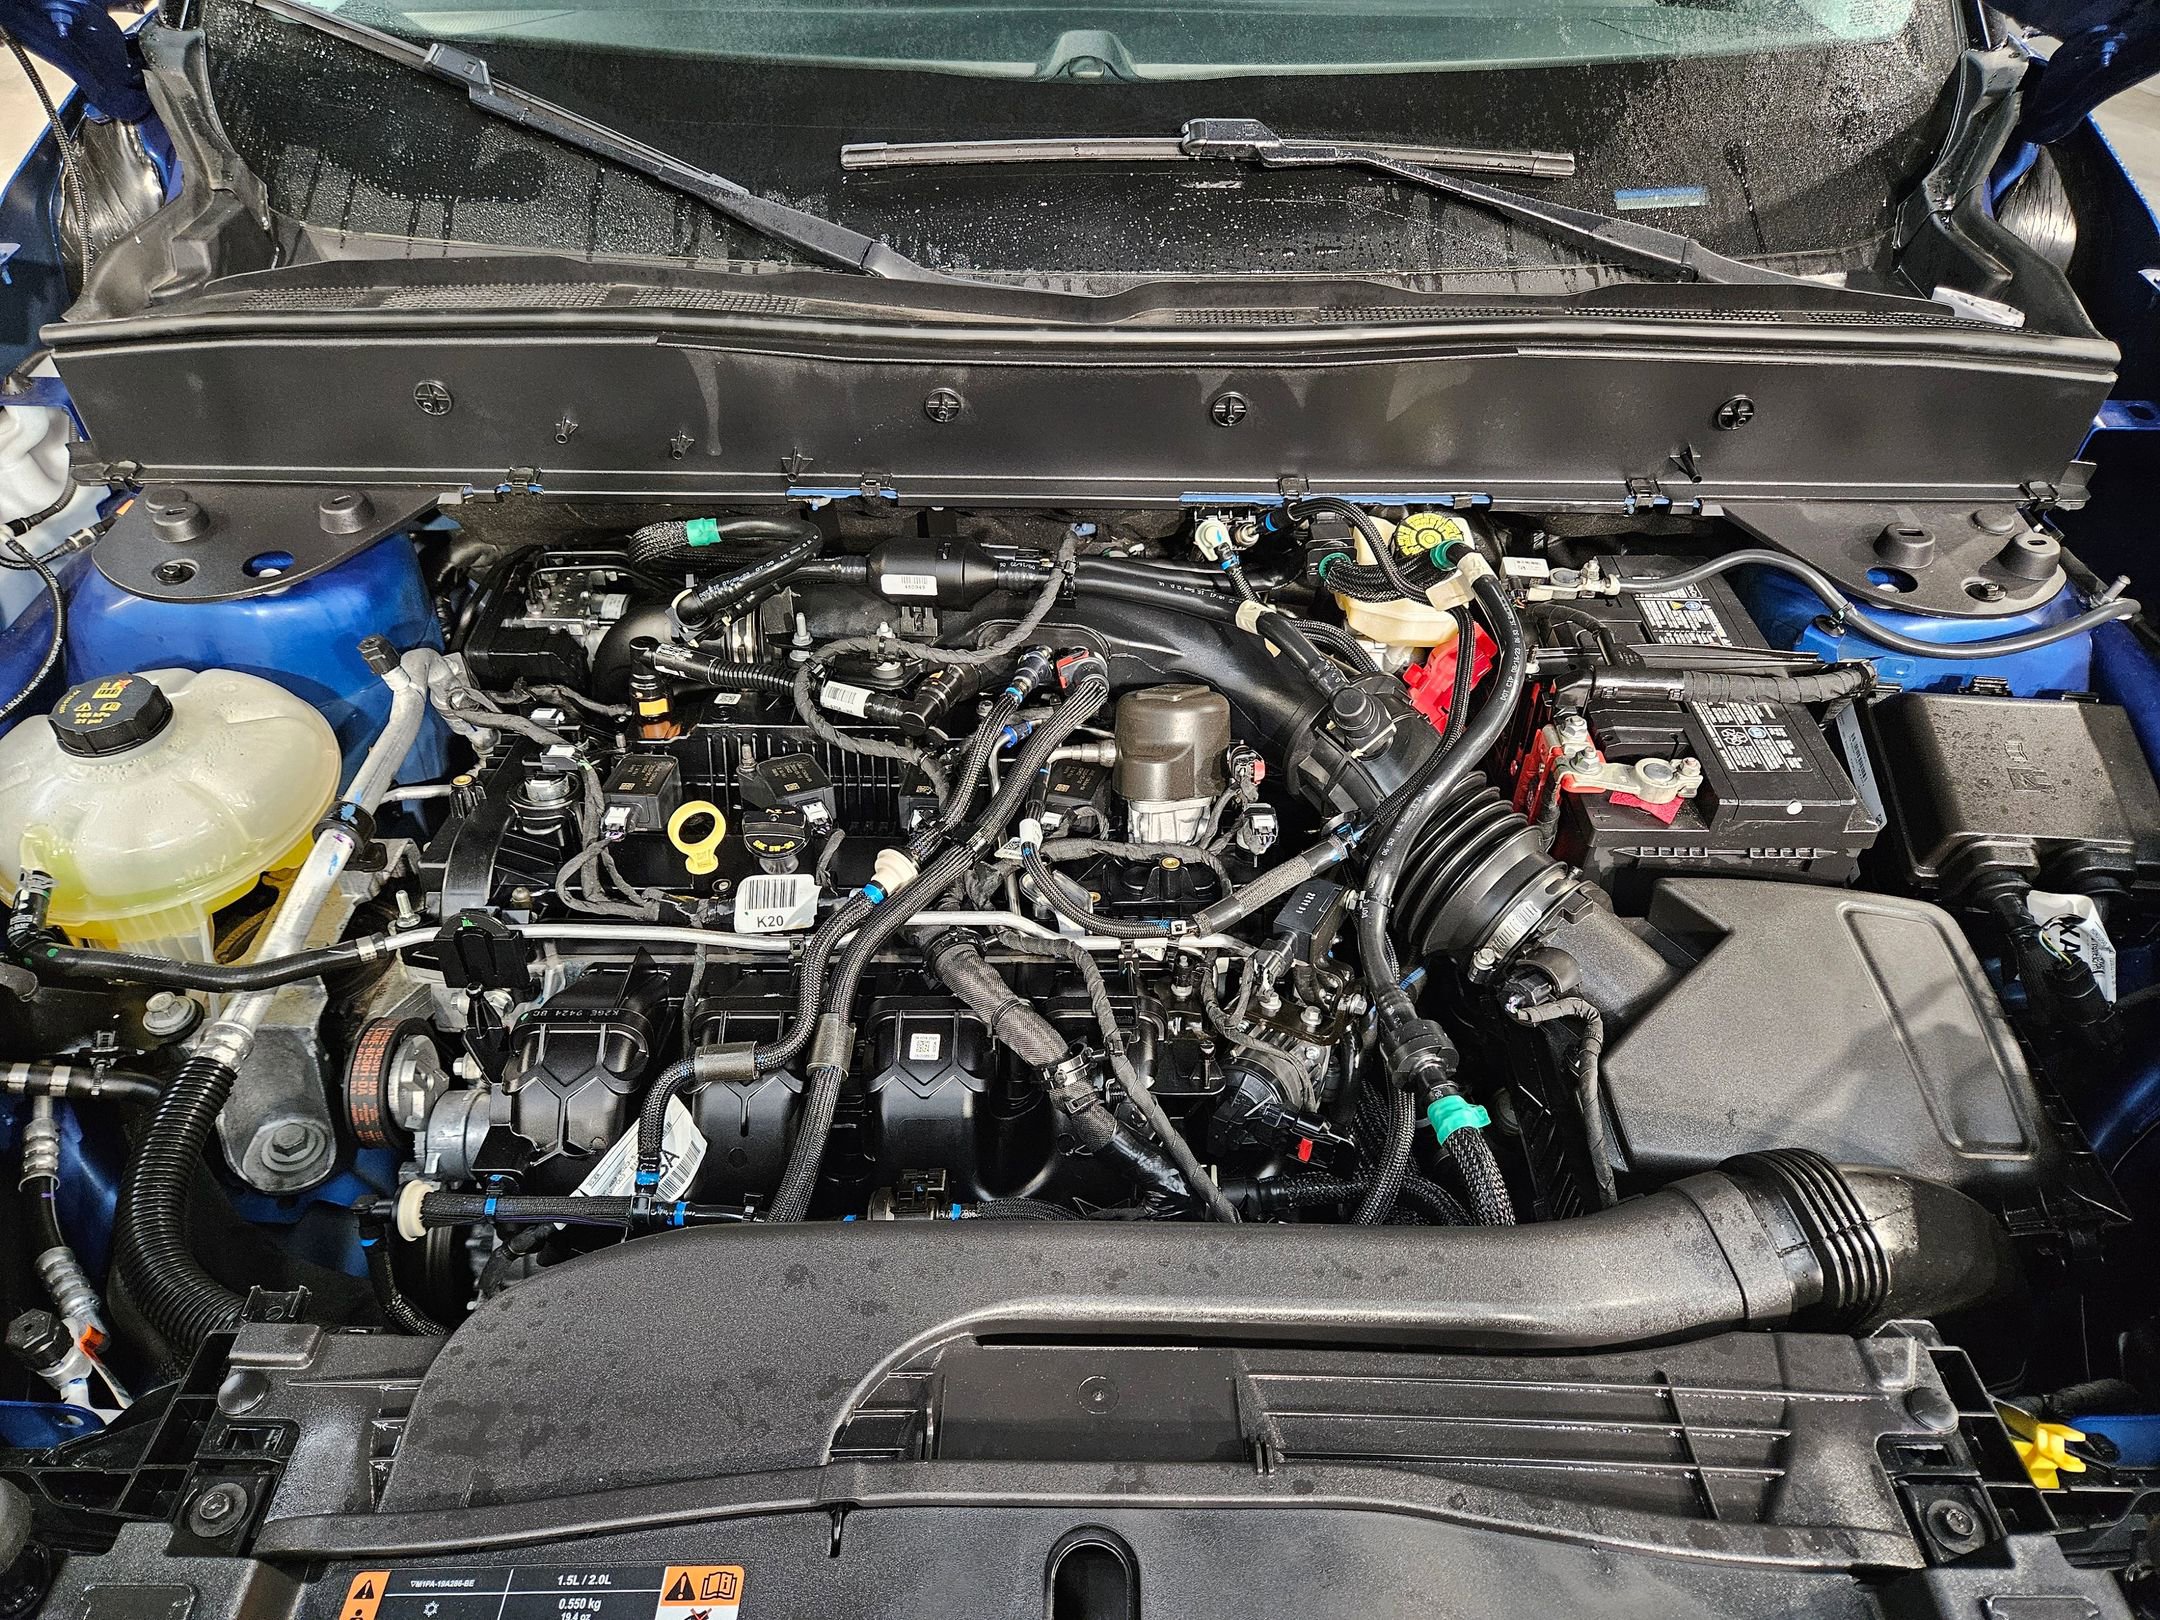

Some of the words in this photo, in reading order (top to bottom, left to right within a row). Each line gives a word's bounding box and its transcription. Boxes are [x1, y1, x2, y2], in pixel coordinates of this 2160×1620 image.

[1500, 689, 1510, 701] DOT
[757, 915, 784, 928] K20
[557, 1574, 580, 1586] 1.5L
[588, 1574, 612, 1585] 2.0L
[558, 1597, 587, 1610] 0.550
[588, 1597, 602, 1612] kg
